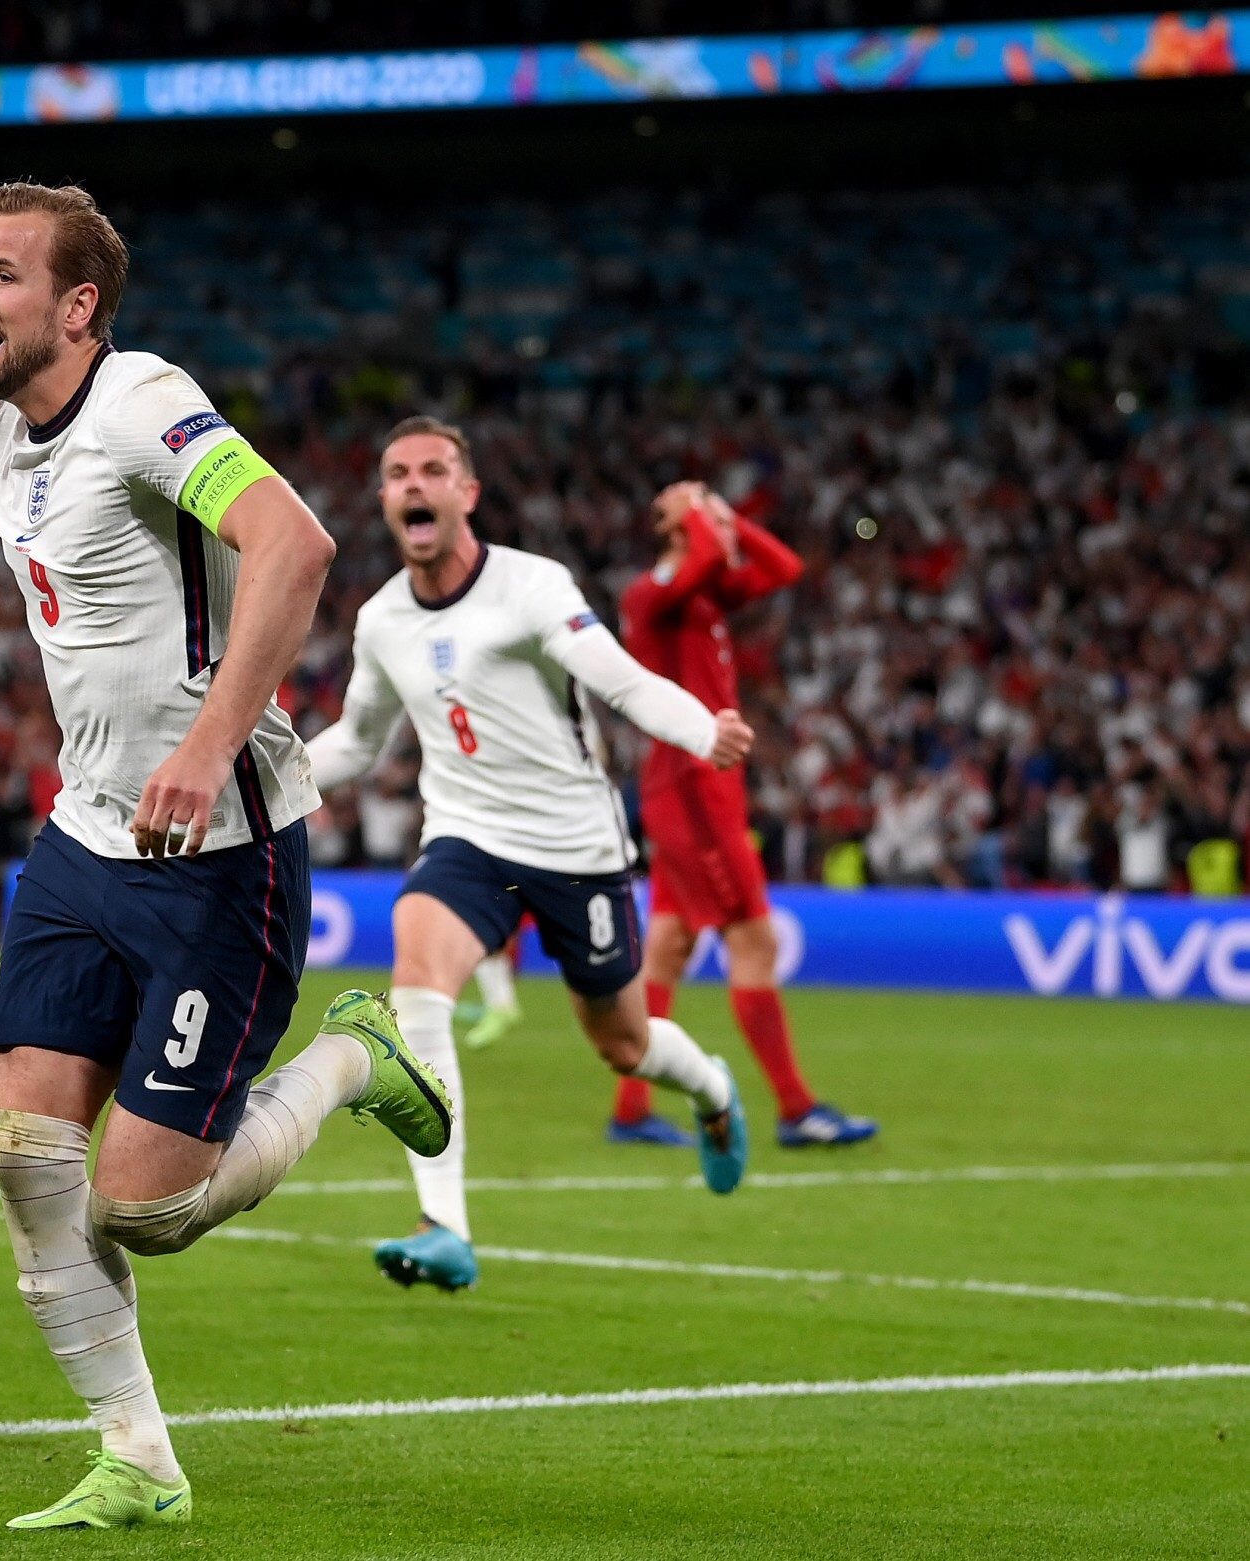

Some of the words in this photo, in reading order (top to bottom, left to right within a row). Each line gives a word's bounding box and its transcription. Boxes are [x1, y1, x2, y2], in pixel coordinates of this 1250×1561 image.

[145, 65, 249, 114] UEFA
[256, 59, 373, 110] EURO
[379, 52, 485, 106] 2020
[183, 416, 225, 434] RESPEC
[189, 470, 214, 510] #EQUAL
[212, 451, 240, 471] GAME
[208, 463, 246, 502] RESPECT
[28, 556, 60, 628] 9
[449, 704, 479, 755] 8
[587, 893, 615, 949] 8
[164, 989, 209, 1068] 9
